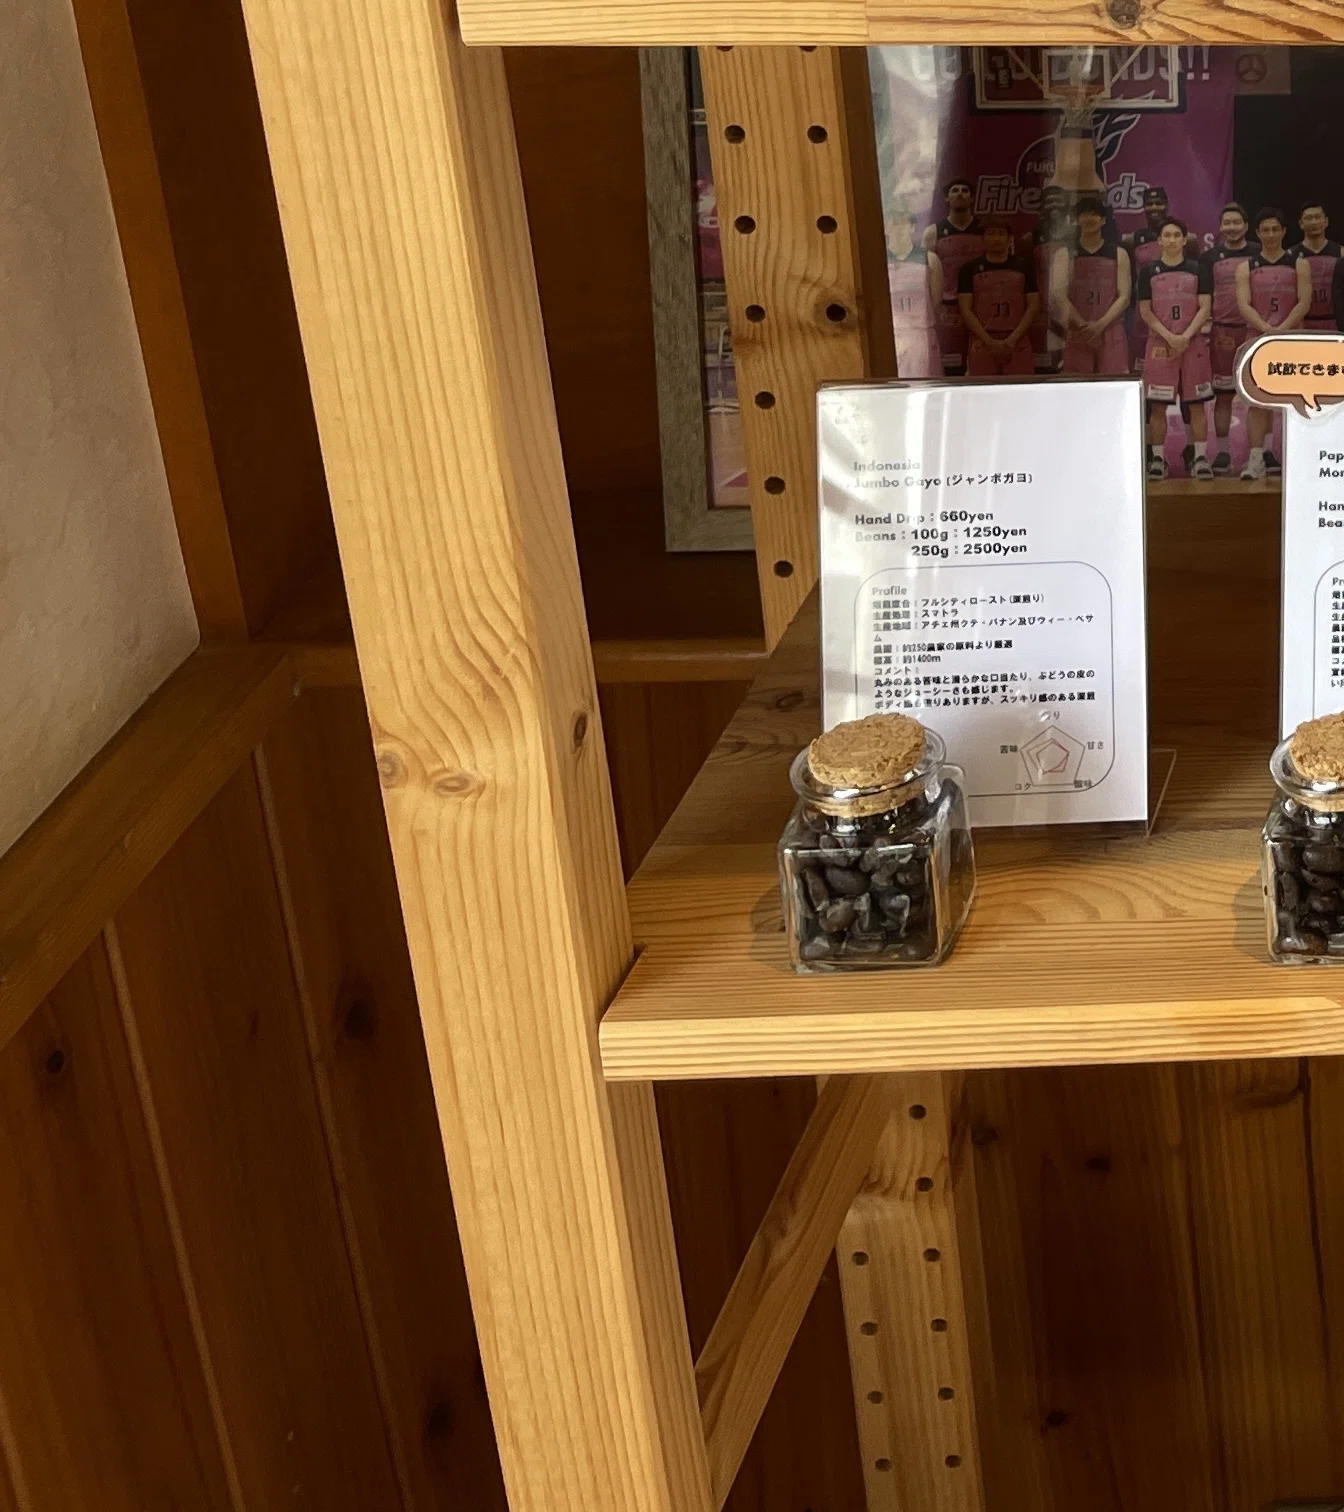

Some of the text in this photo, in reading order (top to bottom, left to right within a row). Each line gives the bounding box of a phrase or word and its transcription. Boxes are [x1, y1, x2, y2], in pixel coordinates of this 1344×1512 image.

[947, 473, 1032, 486] (ジャンボガヨ)
